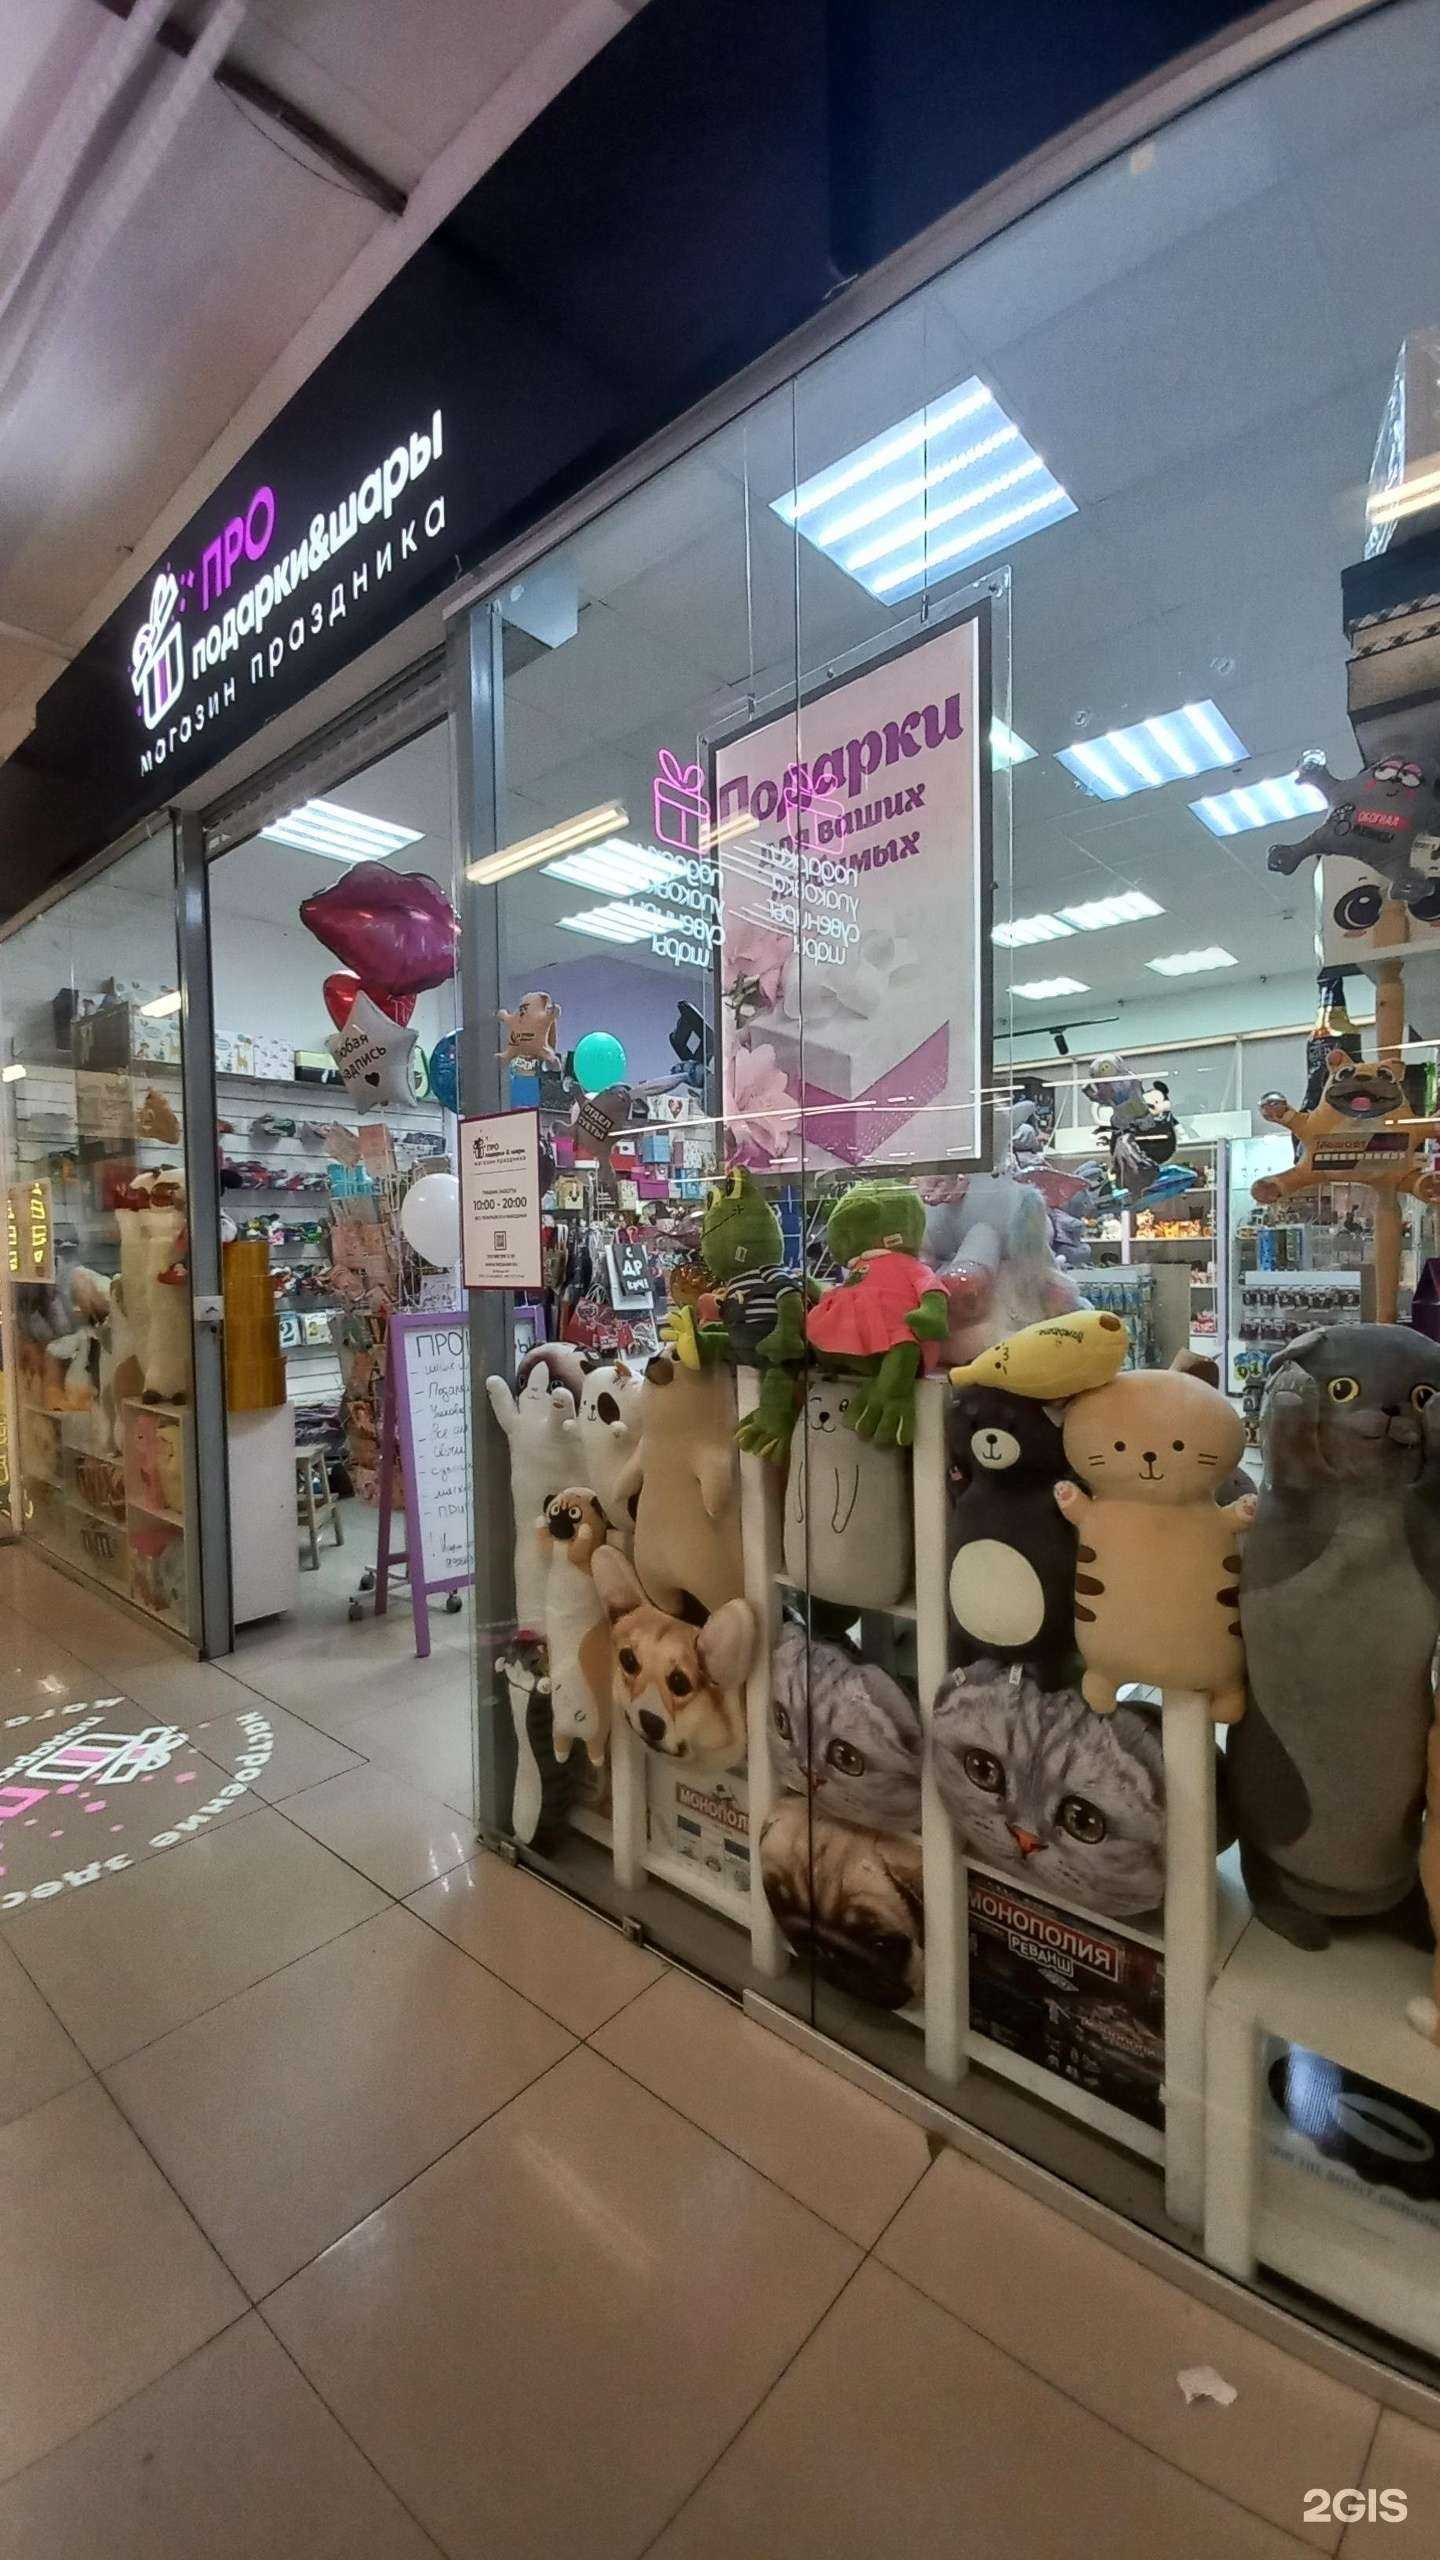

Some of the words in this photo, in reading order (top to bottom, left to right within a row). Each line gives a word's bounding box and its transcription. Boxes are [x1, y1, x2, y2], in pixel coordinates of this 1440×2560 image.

[202, 486, 275, 611] ПРО
[141, 678, 236, 776] магазин
[251, 496, 446, 683] праздника
[719, 692, 965, 823] Подарки
[816, 782, 926, 845] ваших
[503, 1196, 527, 1208] 20:00
[1012, 1935, 1072, 1974] РЕВАНШ
